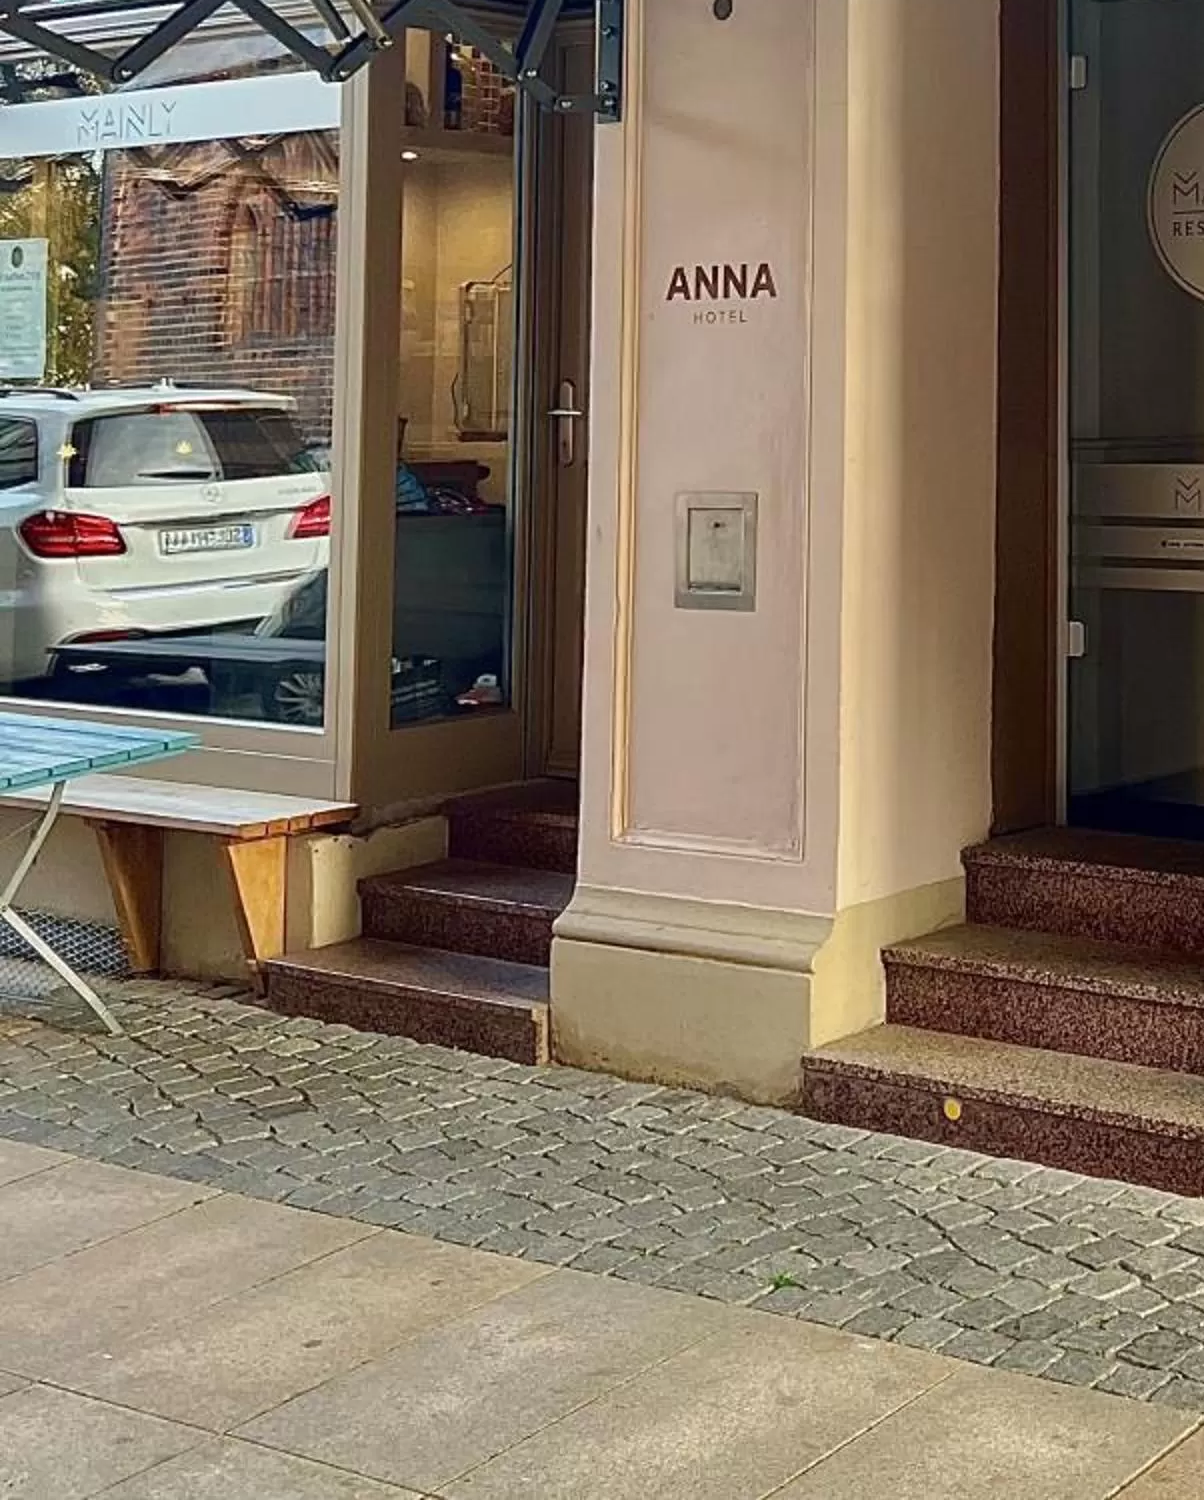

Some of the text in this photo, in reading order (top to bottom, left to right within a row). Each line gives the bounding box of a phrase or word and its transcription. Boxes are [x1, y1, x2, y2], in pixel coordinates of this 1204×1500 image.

[77, 101, 177, 144] MAINLY
[665, 263, 777, 301] ANNA
[693, 309, 748, 325] HOTEL
